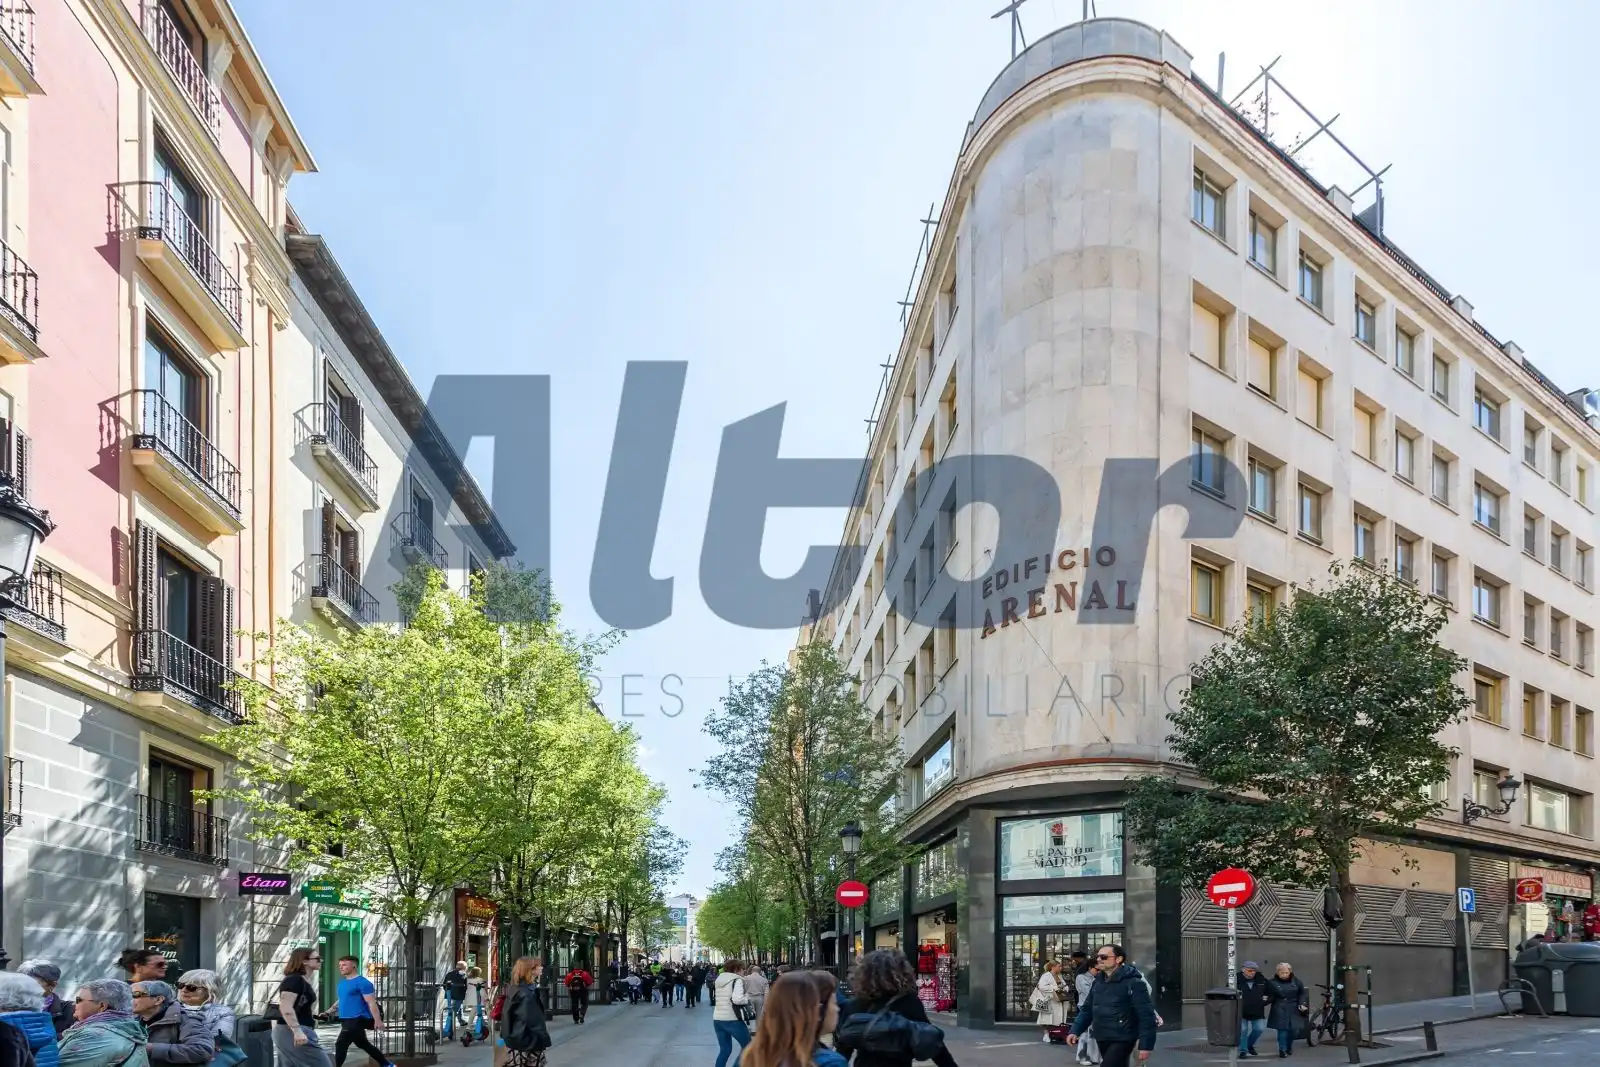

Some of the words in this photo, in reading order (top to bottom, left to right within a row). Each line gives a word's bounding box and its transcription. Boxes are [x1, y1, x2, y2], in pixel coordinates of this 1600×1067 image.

[982, 545, 1116, 599] EDIFICIO
[981, 579, 1135, 639] ARENAL
[1034, 855, 1088, 868] MADRID
[241, 875, 287, 888] Etam
[1462, 890, 1472, 910] P
